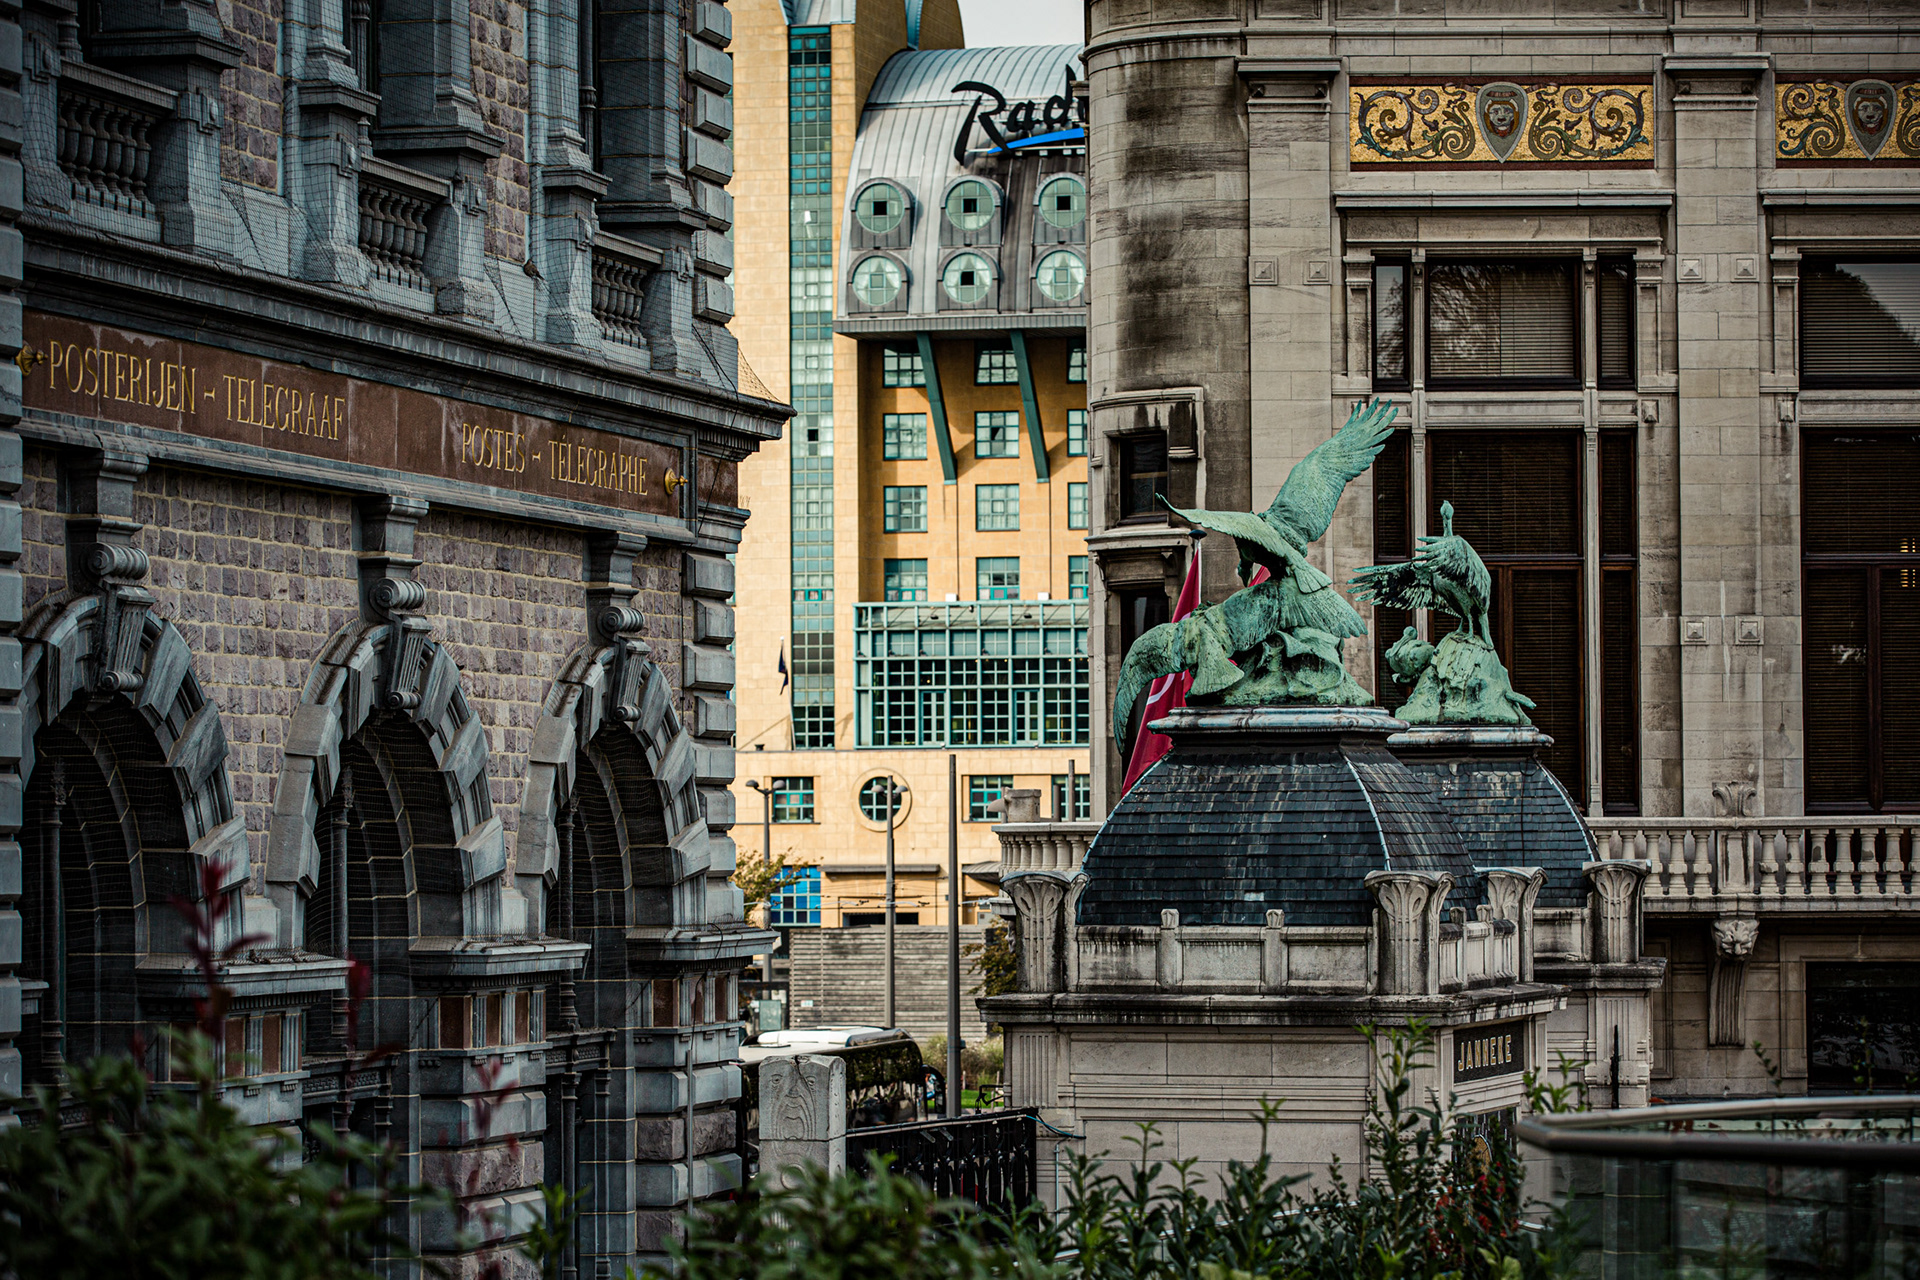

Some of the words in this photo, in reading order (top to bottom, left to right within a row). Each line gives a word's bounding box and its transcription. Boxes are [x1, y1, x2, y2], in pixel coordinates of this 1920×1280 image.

[49, 340, 197, 414] POSTERIJEN
[222, 374, 346, 440] TELEGRAAF
[462, 422, 525, 474] POSTES
[548, 434, 649, 496] TÉLÉGRAPHE
[1457, 1034, 1512, 1072] JANNEKE
